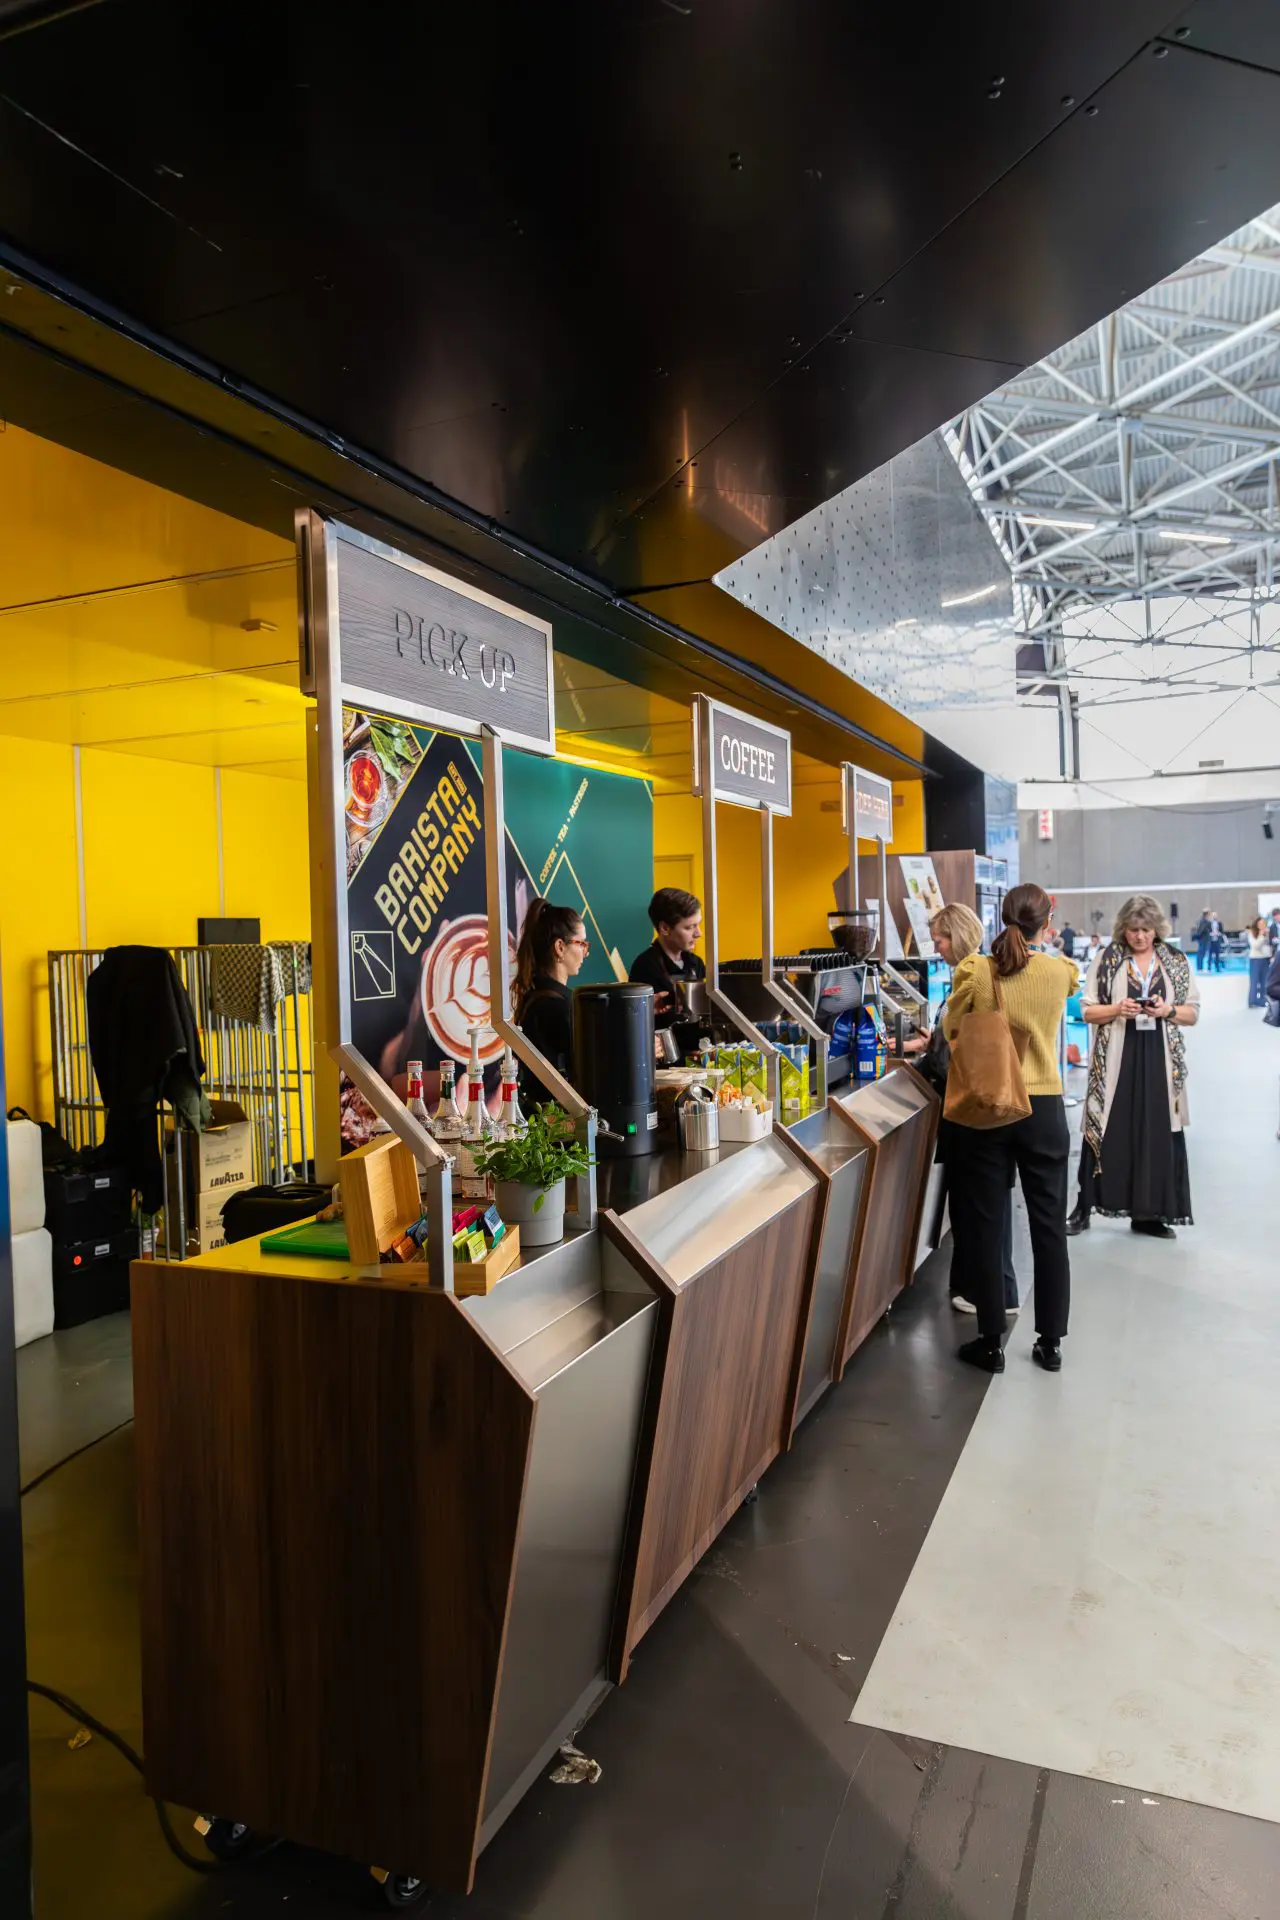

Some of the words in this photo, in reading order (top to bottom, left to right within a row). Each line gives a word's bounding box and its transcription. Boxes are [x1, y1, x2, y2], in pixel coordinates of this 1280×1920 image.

[393, 605, 470, 681] PICK
[479, 643, 516, 693] UP
[721, 734, 776, 785] COFFEE
[374, 776, 461, 926] BARISTA
[397, 794, 482, 955] COMPANY
[210, 1171, 244, 1188] LAVAZZA
